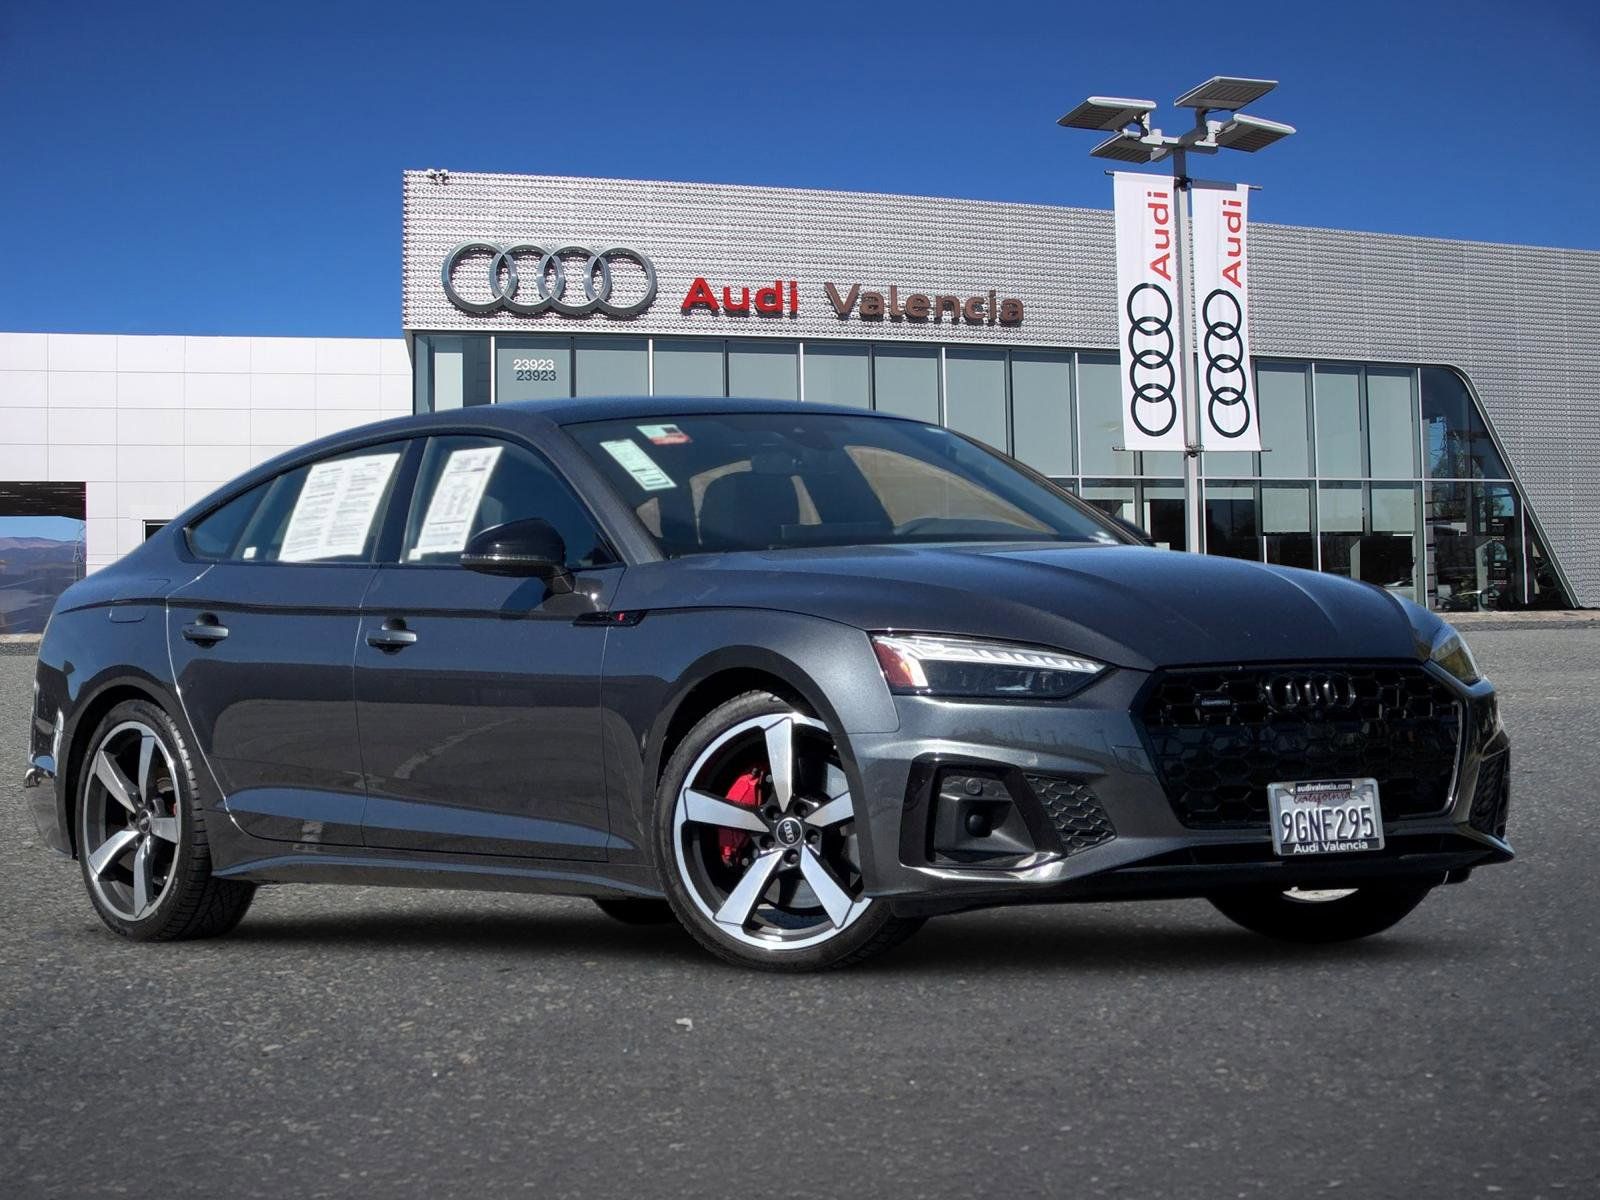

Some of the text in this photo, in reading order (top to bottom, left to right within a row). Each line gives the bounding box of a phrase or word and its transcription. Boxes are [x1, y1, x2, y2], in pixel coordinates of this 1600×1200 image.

[1147, 191, 1172, 282] Audi
[1222, 199, 1243, 288] Audi
[681, 277, 1025, 324] Audi Valencia
[513, 358, 555, 371] 23923
[516, 369, 557, 382] 23923
[1297, 783, 1351, 793] audivalencia.com
[1281, 806, 1376, 843] 9GNF295
[1294, 839, 1369, 854] Audi Valencia
